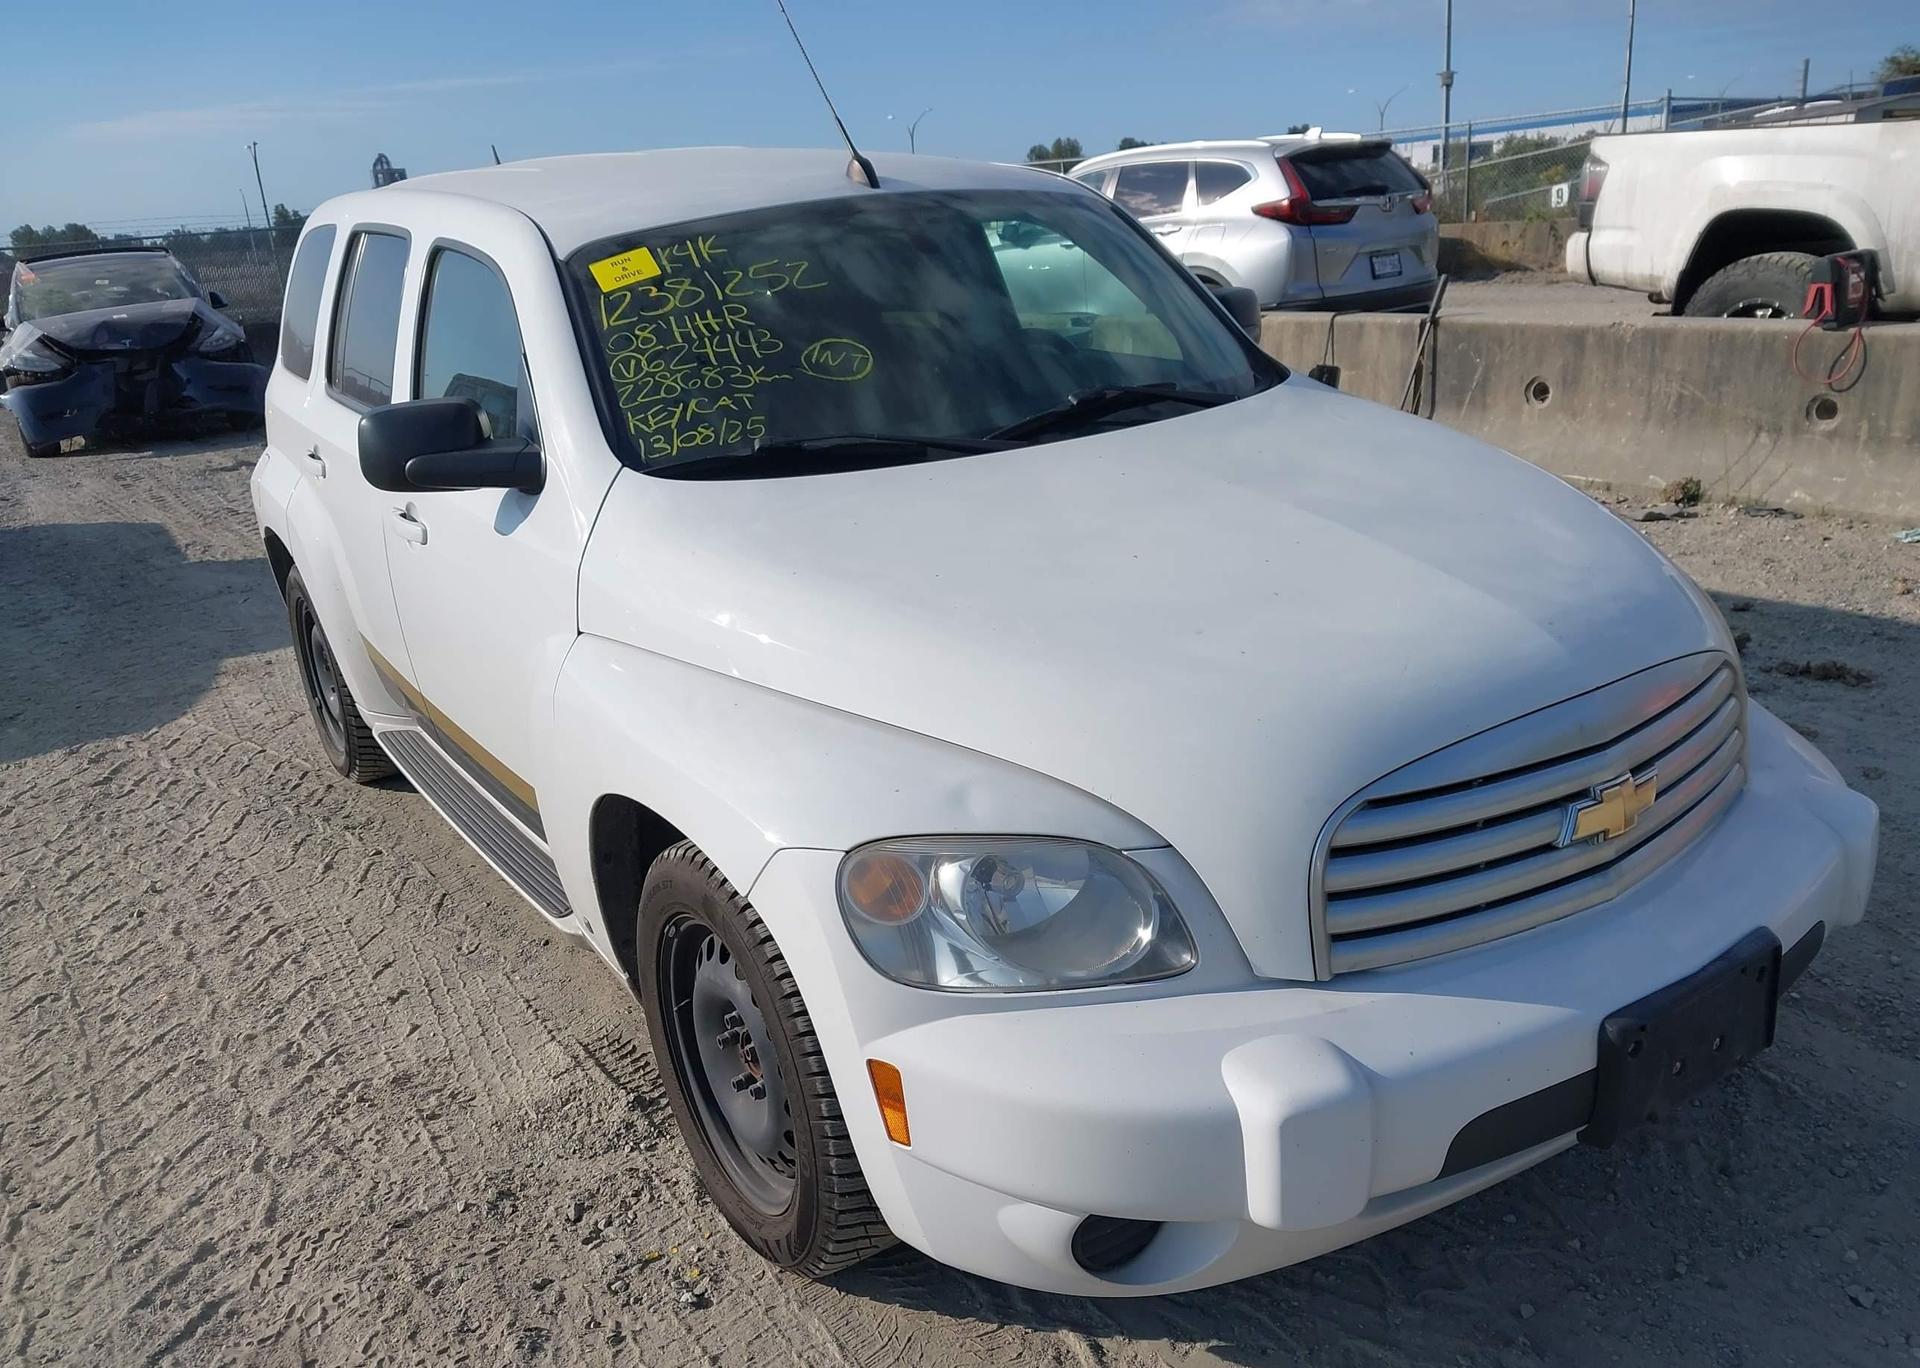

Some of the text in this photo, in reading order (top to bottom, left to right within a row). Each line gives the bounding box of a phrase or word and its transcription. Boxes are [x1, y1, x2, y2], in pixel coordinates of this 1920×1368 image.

[1556, 187, 1564, 205] 9
[610, 256, 632, 268] RUN
[621, 265, 629, 273] &
[614, 268, 644, 283] DRIVE
[669, 304, 756, 343] HHR
[811, 342, 870, 372] INT
[638, 415, 766, 465] 13/08/25
